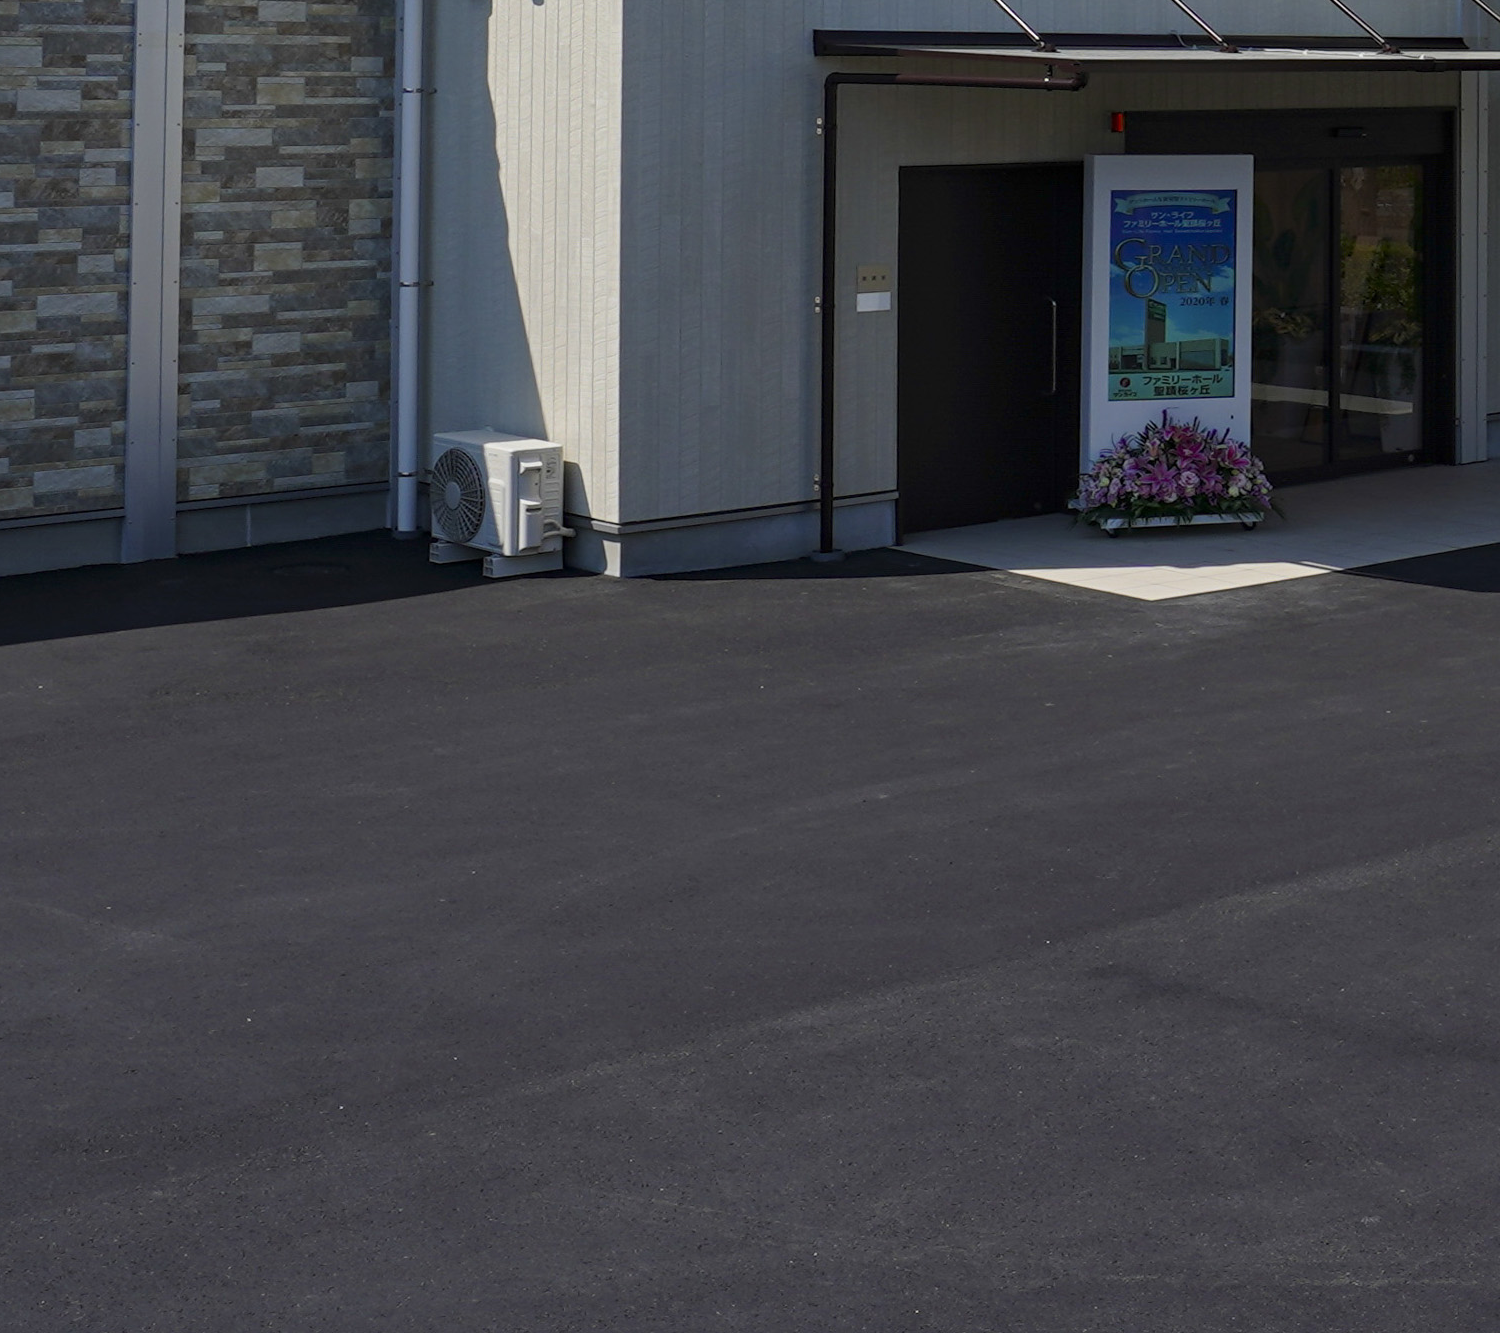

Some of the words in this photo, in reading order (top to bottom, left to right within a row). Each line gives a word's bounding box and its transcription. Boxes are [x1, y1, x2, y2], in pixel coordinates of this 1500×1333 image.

[1115, 237, 1231, 272] GRAND
[1124, 264, 1212, 298] OPEN
[1142, 374, 1223, 385] ファミリーホール
